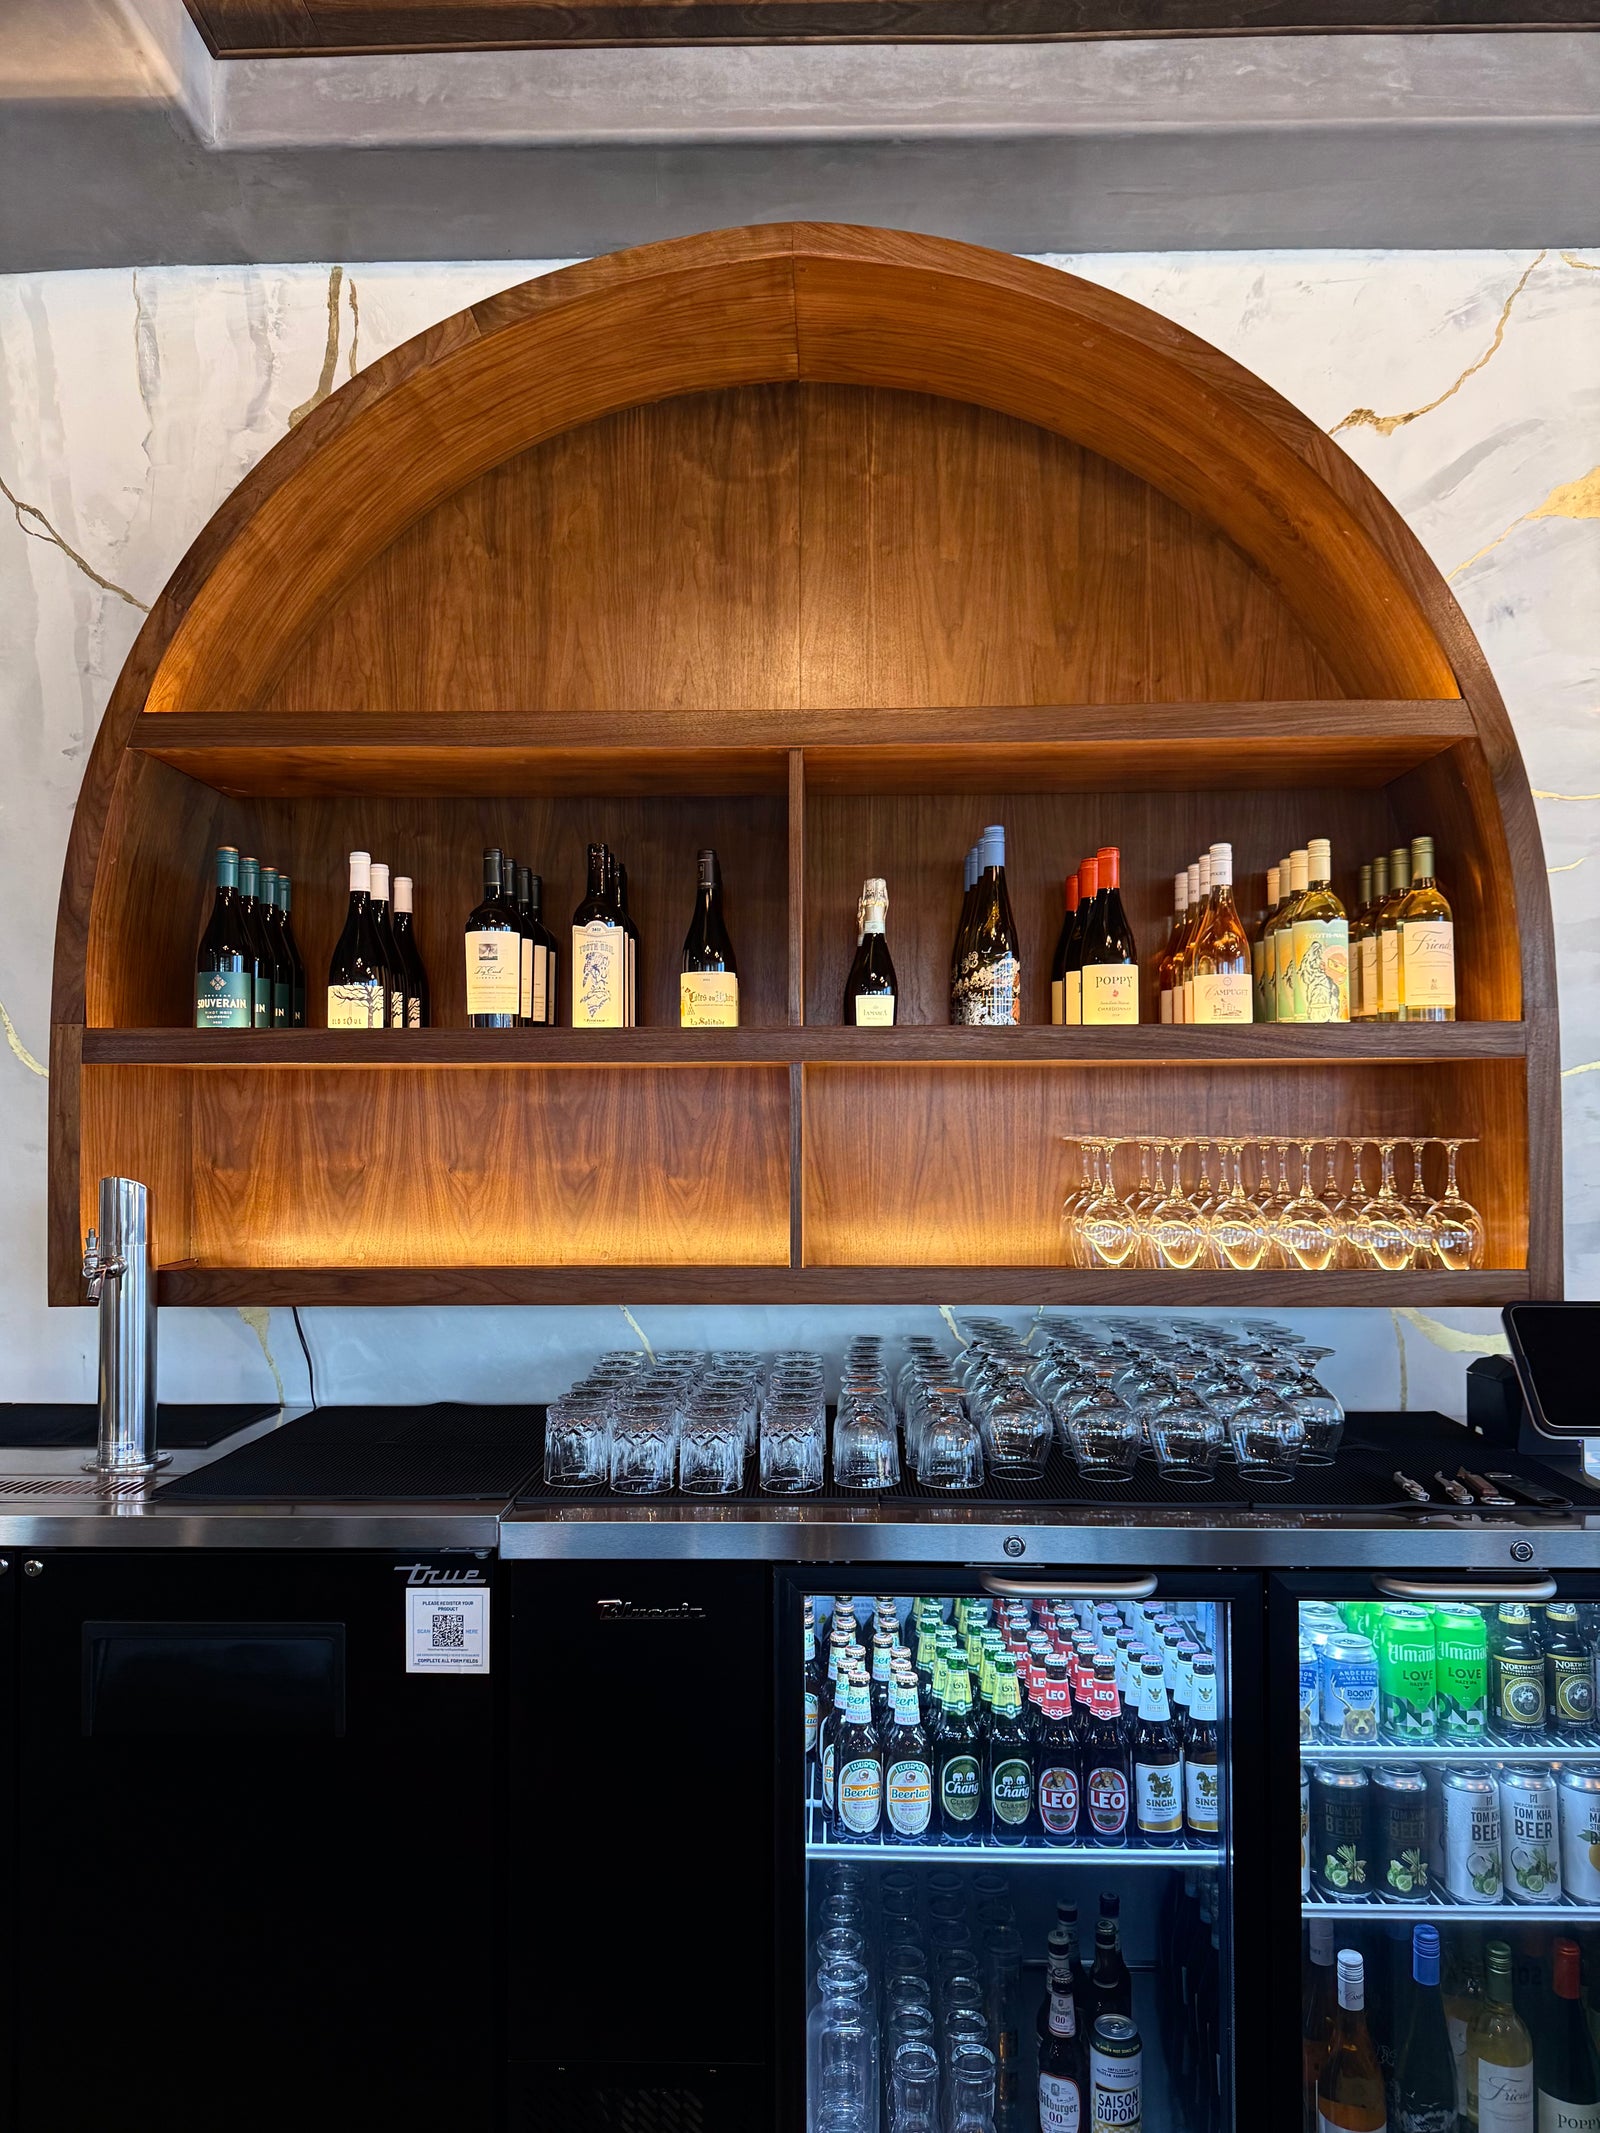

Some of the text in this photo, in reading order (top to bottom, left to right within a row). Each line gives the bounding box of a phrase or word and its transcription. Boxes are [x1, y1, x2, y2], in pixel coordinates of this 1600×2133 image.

[1096, 976, 1133, 988] POPPY
[197, 998, 247, 1009] SOUVERAIN
[1500, 1661, 1528, 1671] NORTH
[1555, 1660, 1583, 1669] NORTH
[1403, 1669, 1434, 1680] LOVE
[1448, 1667, 1482, 1679] LOVE
[1033, 1677, 1046, 1688] LE
[1081, 1677, 1093, 1688] LE
[1045, 1689, 1066, 1701] LEO
[1094, 1689, 1115, 1701] LEO
[1347, 1689, 1374, 1697] BOONT
[843, 1785, 880, 1797] Beerlao
[891, 1786, 929, 1799] Beerlao
[945, 1780, 979, 1795] Chang
[995, 1784, 1030, 1799] Chang
[1042, 1790, 1076, 1809] LEO
[1090, 1790, 1125, 1809] LEO
[1146, 1798, 1177, 1808] SINGHA
[1195, 1797, 1218, 1807] SING
[1325, 1803, 1343, 1816] TOM
[1513, 1805, 1535, 1820] TOM
[1536, 1808, 1553, 1821] KHA
[1471, 1811, 1490, 1823] TOM
[1325, 1815, 1362, 1836] BEER
[1390, 1820, 1425, 1839] BEER
[1514, 1818, 1553, 1839] BEER
[1098, 2088, 1139, 2109] SAISON
[1097, 2102, 1140, 2123] DUPONT
